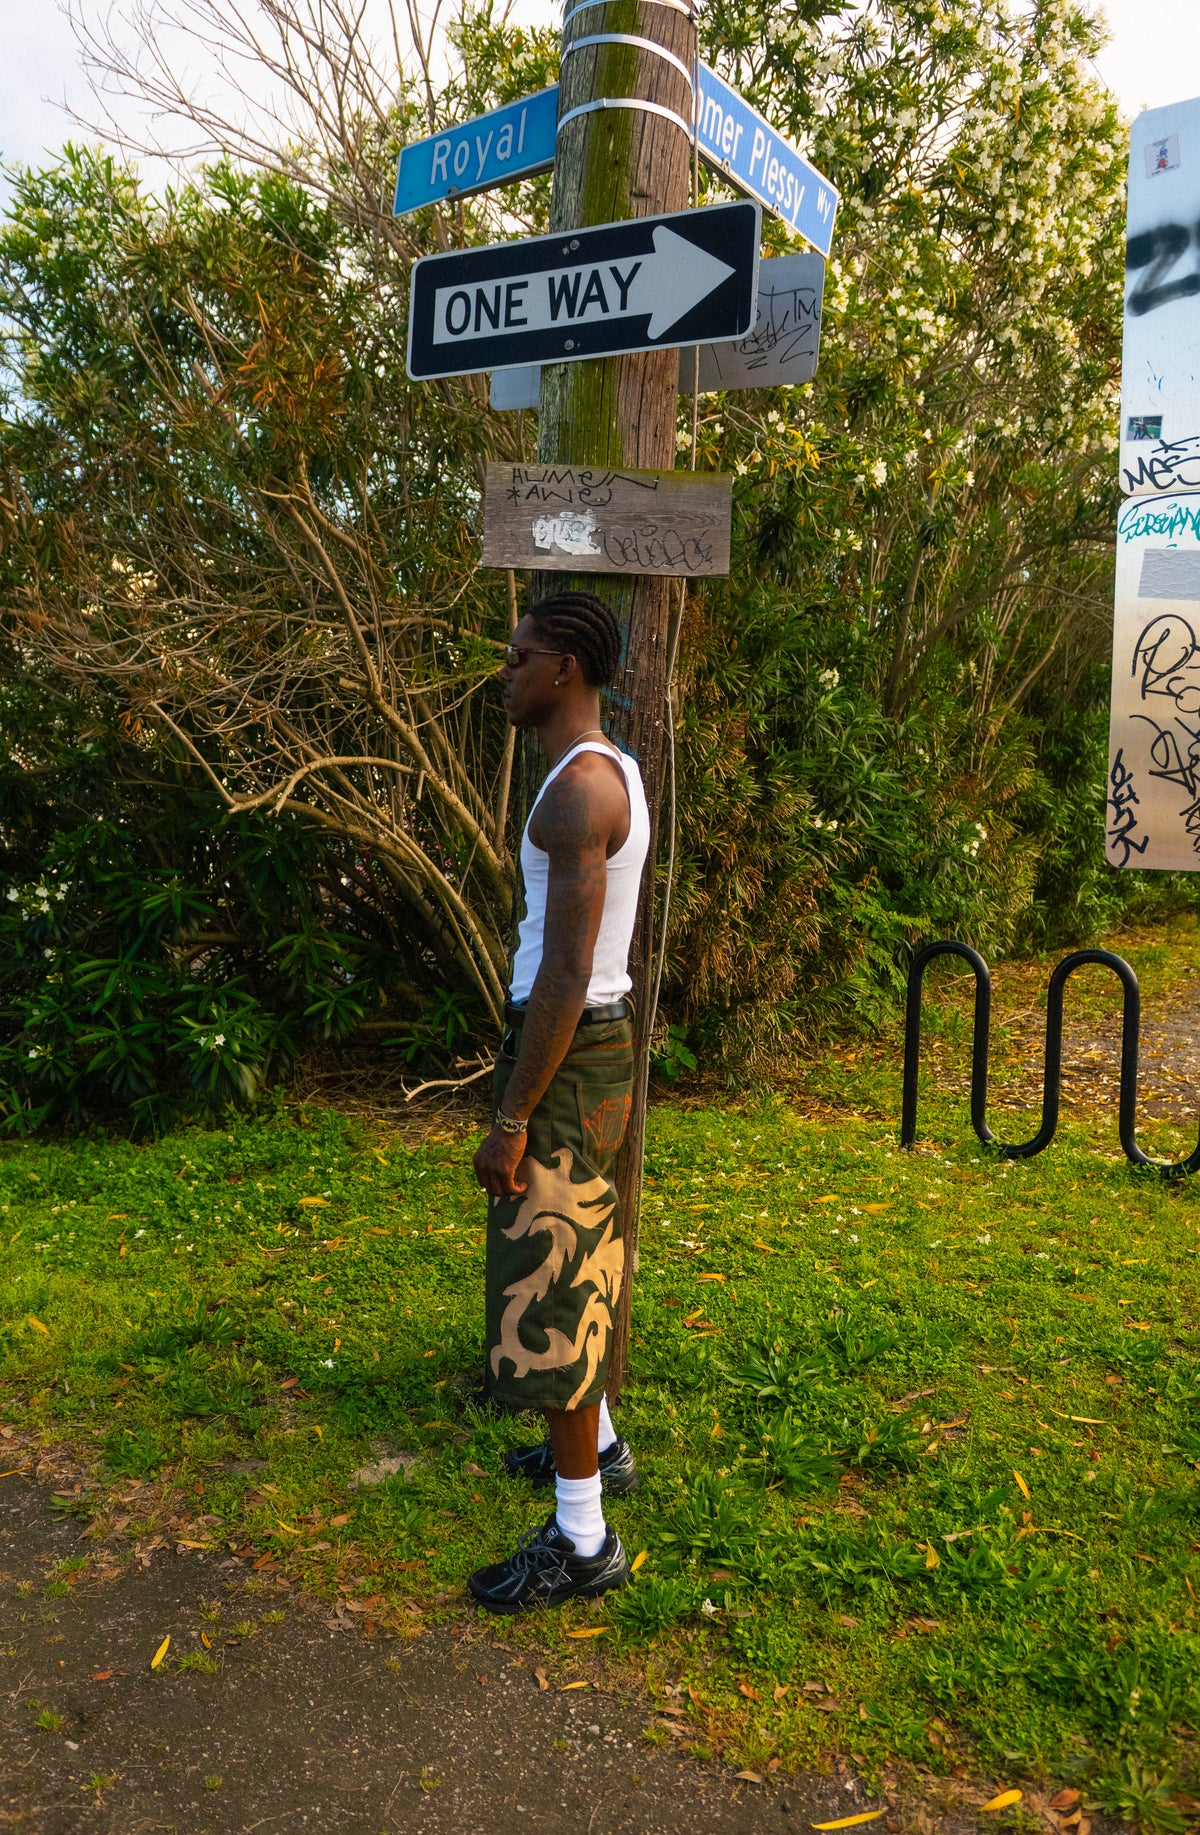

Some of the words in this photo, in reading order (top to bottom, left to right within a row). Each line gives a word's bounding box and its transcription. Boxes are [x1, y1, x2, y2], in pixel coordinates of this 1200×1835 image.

[430, 107, 527, 185] Royal
[749, 127, 805, 226] Plessy
[445, 281, 529, 336] ONE
[548, 262, 643, 321] WAY
